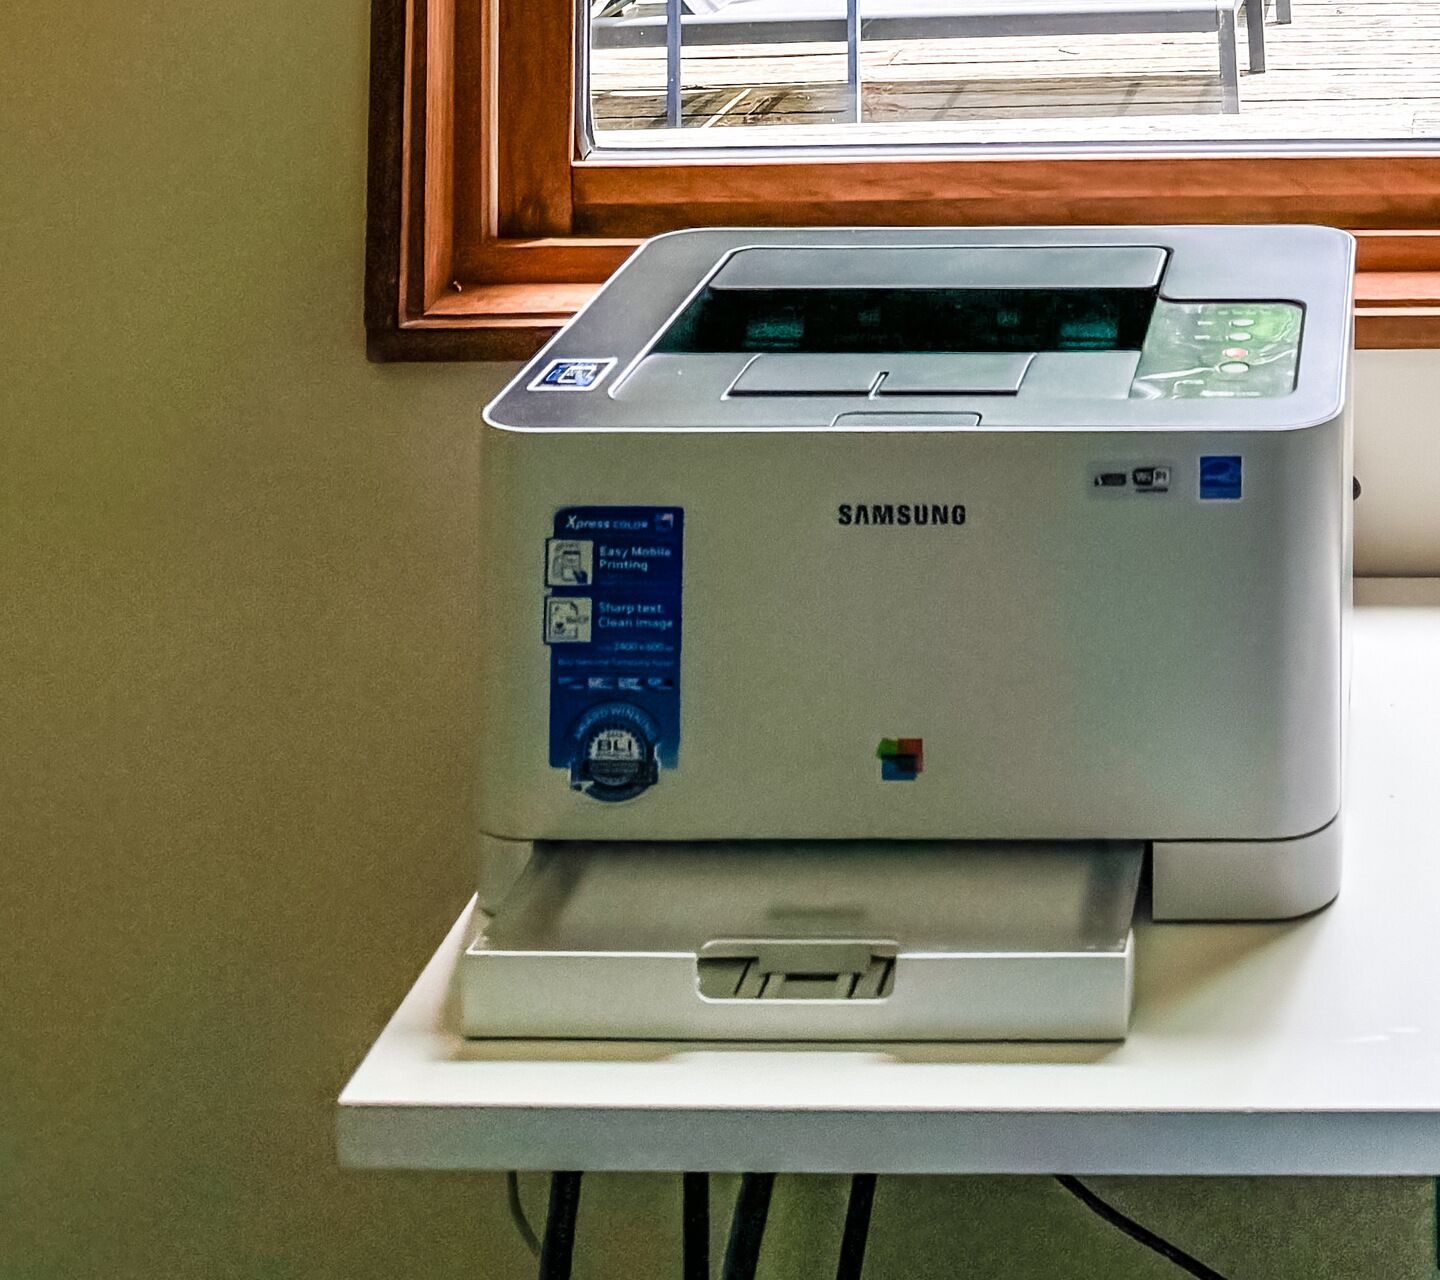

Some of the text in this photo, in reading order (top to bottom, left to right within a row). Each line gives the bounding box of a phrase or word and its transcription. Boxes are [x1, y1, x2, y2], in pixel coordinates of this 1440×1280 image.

[838, 504, 966, 525] SAMSUNG
[565, 514, 610, 530] Xpress
[599, 545, 672, 559] Easy Mobile
[599, 559, 649, 572] Printing
[598, 602, 635, 615] Sharp
[598, 617, 674, 631] Clean image
[597, 739, 632, 752] BLI
